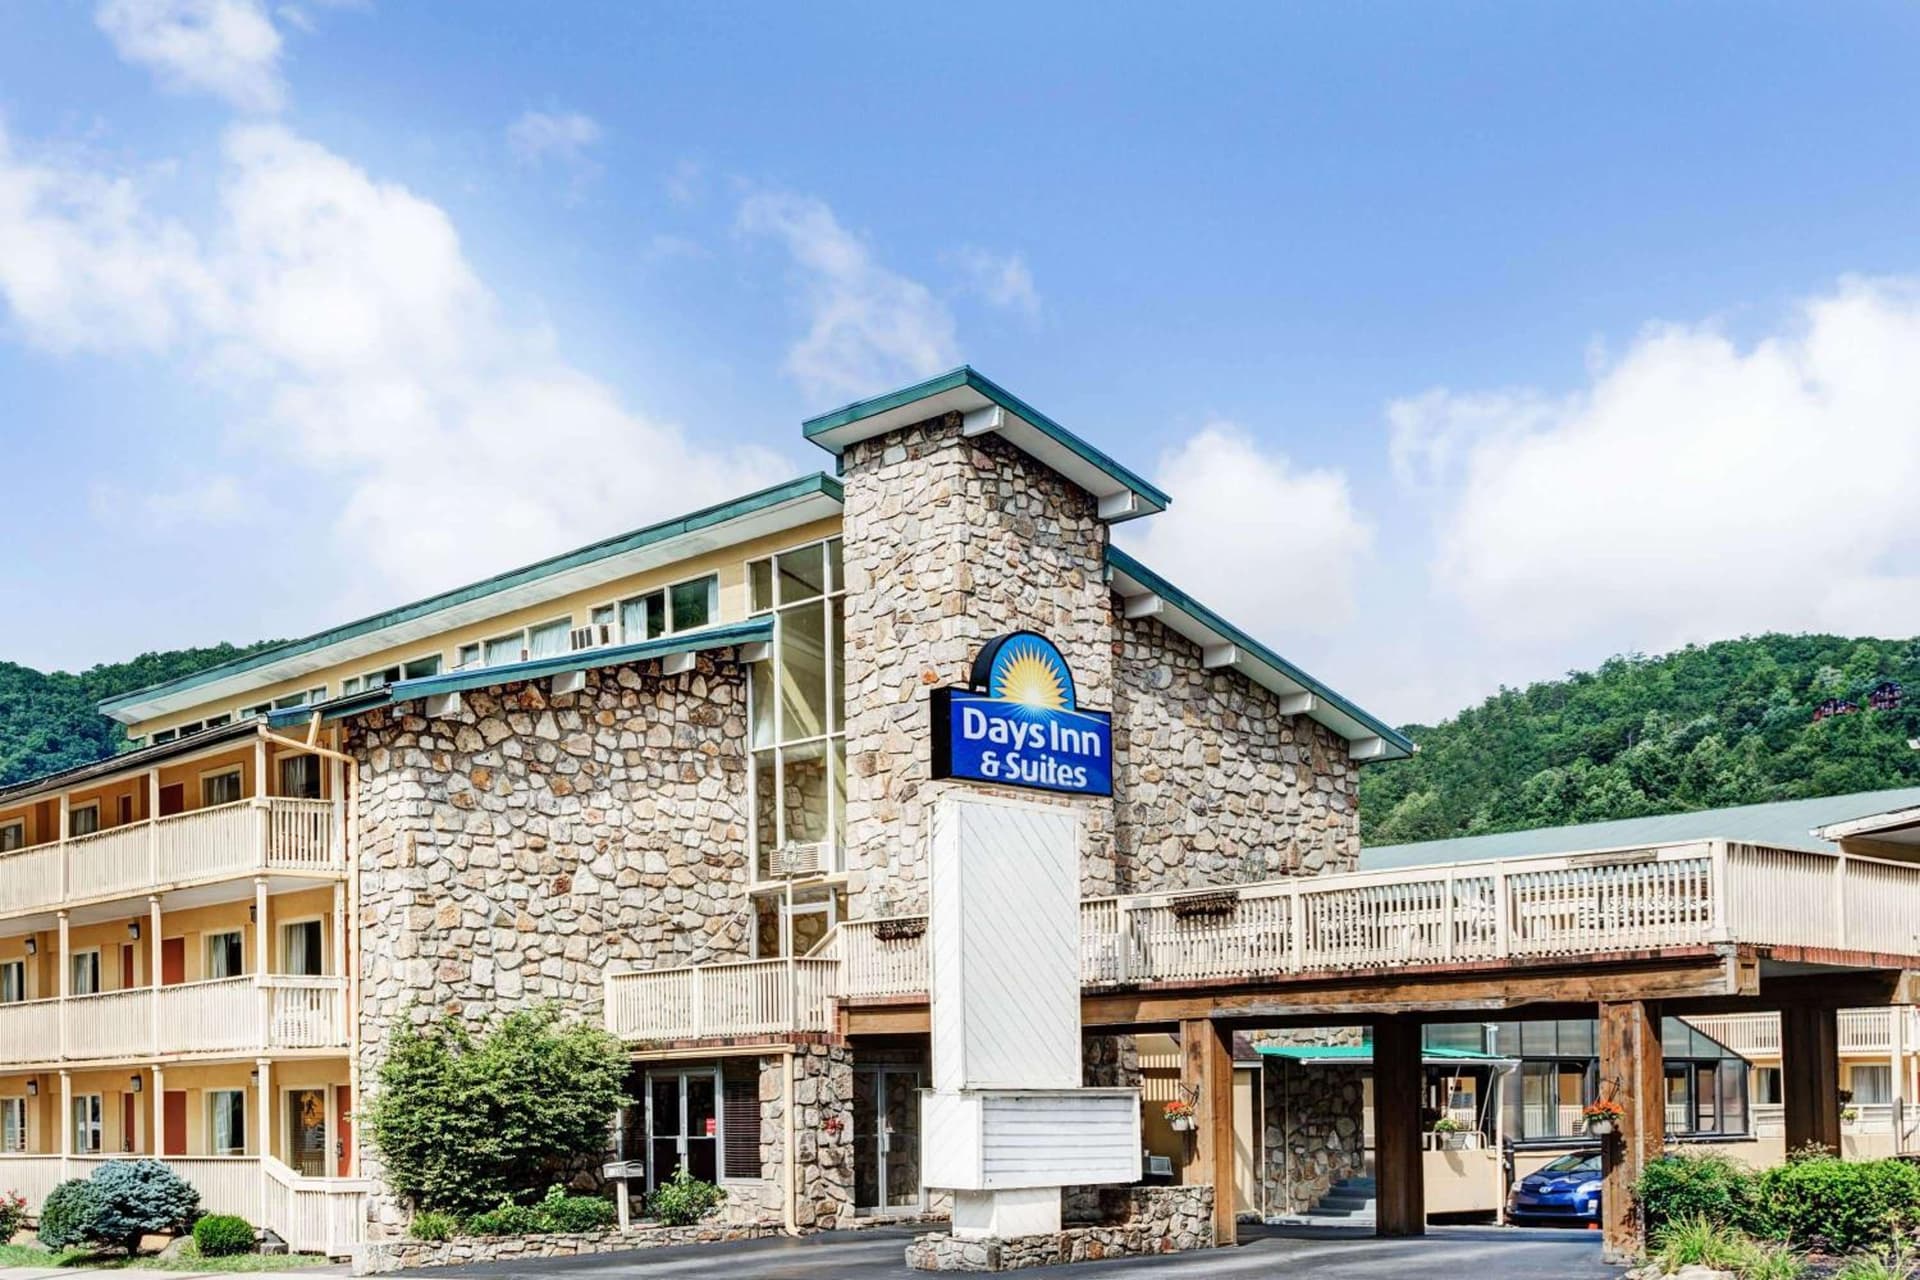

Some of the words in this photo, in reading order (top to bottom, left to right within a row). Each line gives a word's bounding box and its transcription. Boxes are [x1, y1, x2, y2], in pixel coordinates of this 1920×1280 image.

[963, 707, 1046, 750] Days
[1051, 721, 1101, 757] Inn
[980, 750, 1000, 777] &
[1005, 752, 1087, 788] Suites
